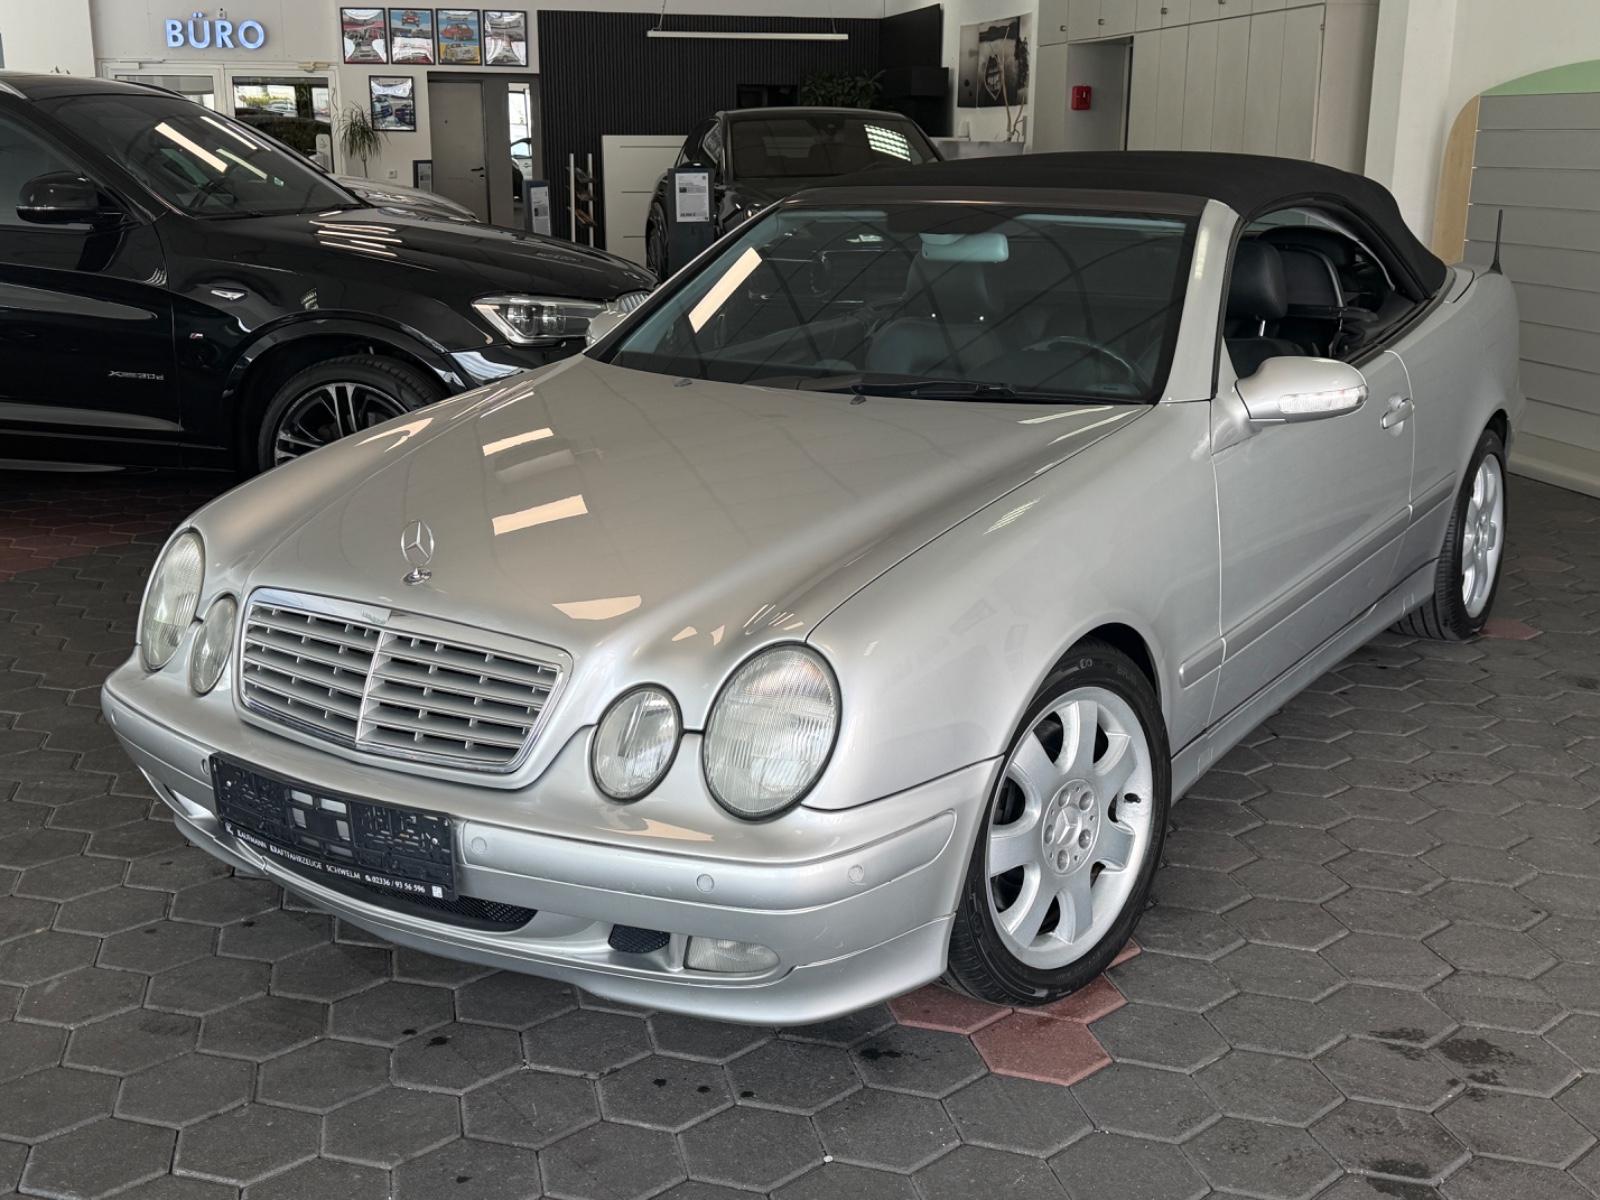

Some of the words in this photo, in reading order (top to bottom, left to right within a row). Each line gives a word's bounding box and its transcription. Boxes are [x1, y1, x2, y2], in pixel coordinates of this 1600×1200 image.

[165, 12, 265, 49] BÜRO
[269, 844, 322, 869] KRAFTFAHRZEUGE
[325, 864, 361, 879] SCHWELM
[371, 876, 391, 886] 02336
[394, 880, 403, 889] 93
[404, 882, 412, 891] 56
